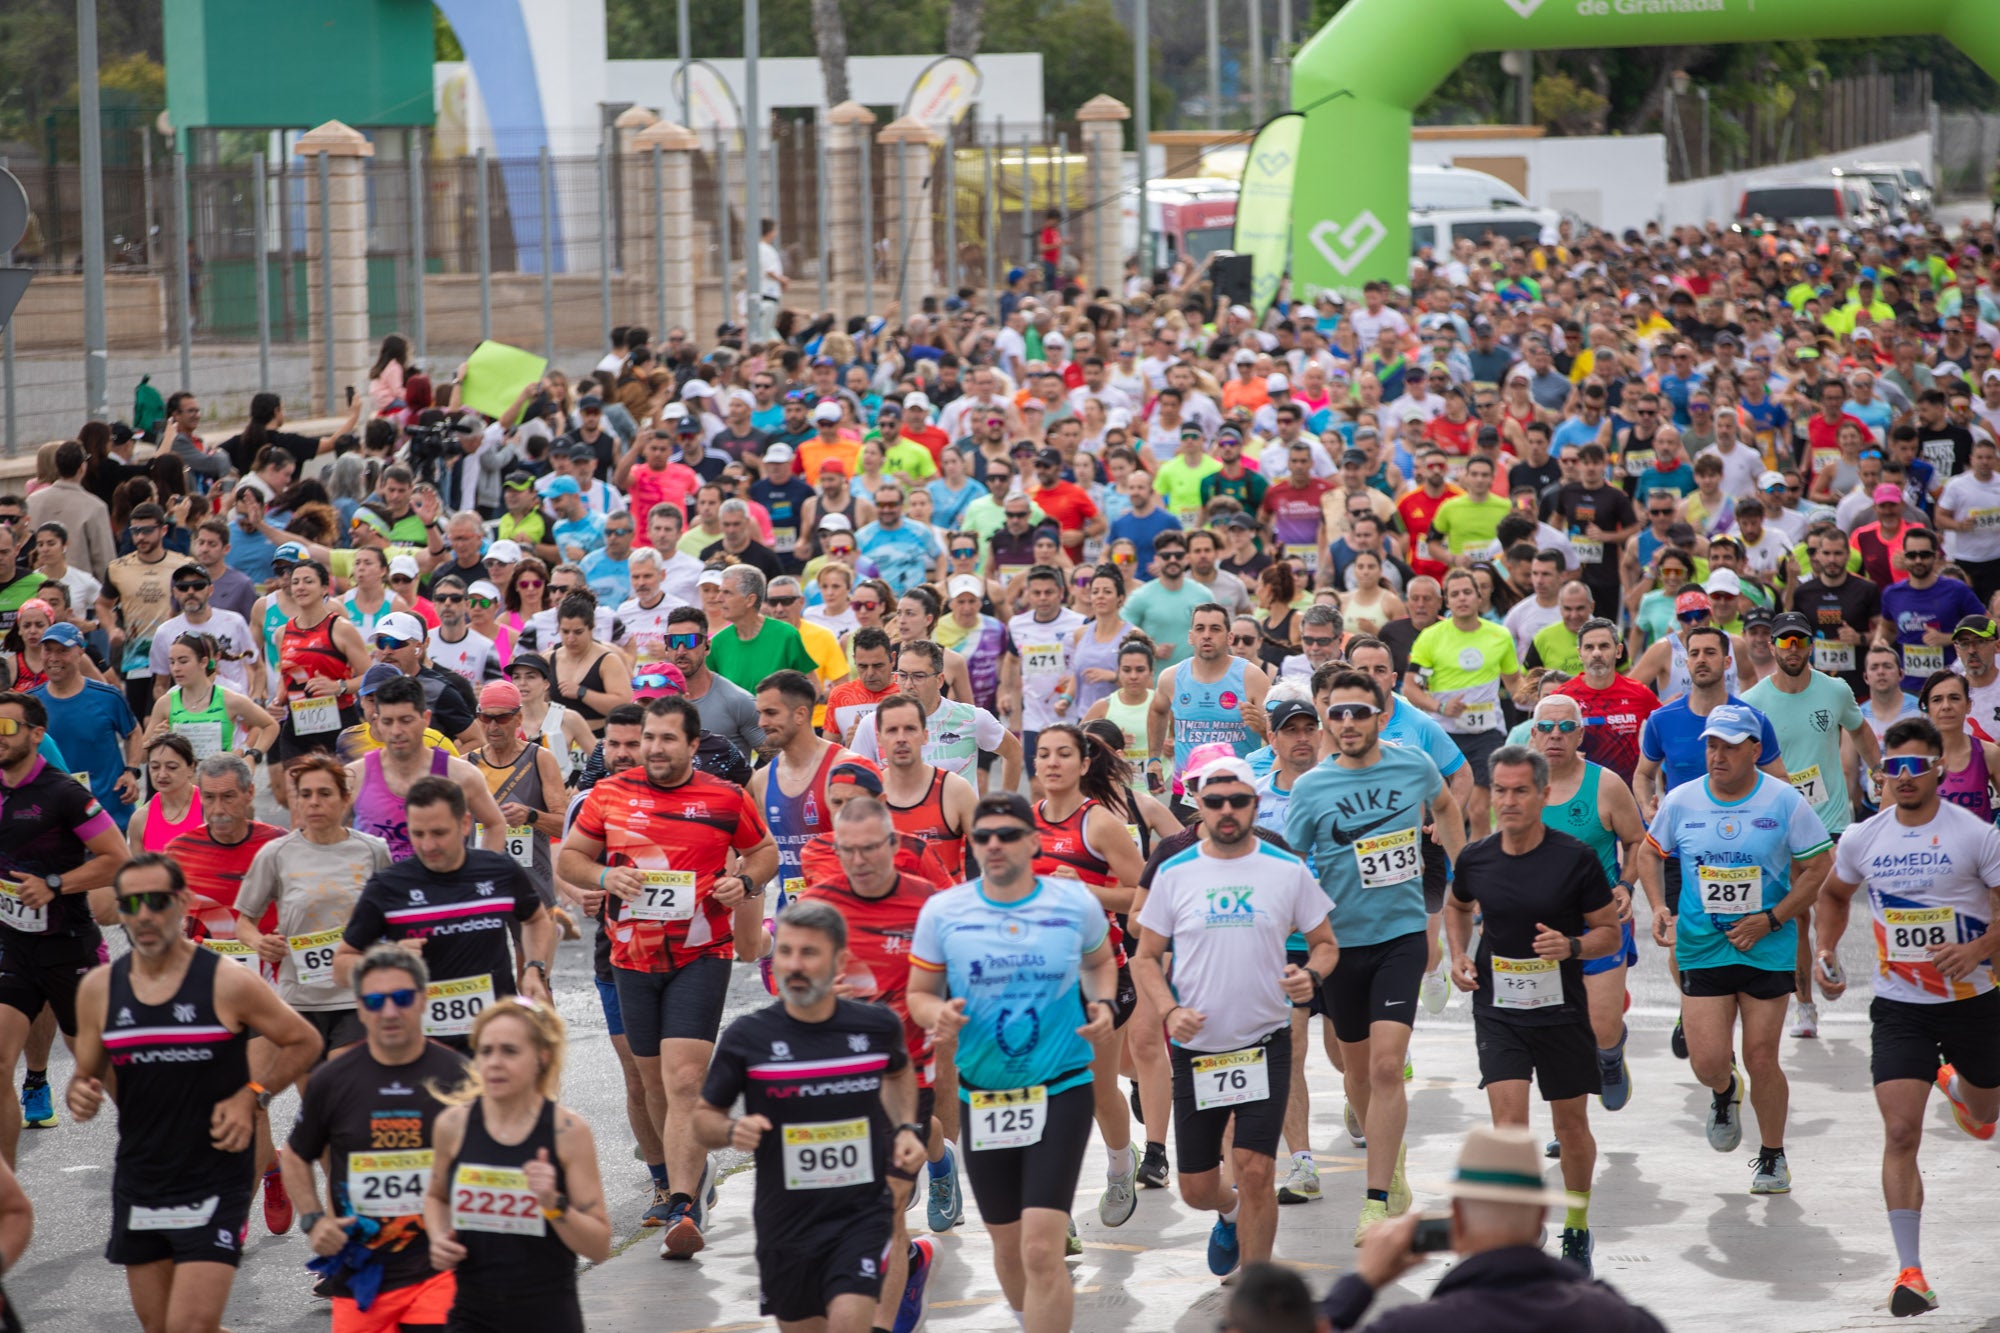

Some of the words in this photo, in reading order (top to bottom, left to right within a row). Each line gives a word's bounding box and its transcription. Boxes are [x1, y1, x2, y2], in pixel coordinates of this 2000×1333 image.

[1577, 0, 1609, 16] de
[1614, 0, 1724, 14] Granada
[1029, 654, 1057, 667] 471
[1907, 656, 1942, 669] 3046
[1467, 714, 1485, 726] 31
[1606, 713, 1637, 725] SEUR
[1187, 731, 1247, 743] ESTEPONA
[1335, 788, 1402, 819] NIKE
[1361, 846, 1417, 876] 3133
[1709, 851, 1753, 863] PINTURAS
[645, 888, 675, 907] 72
[1206, 891, 1253, 914] 10K
[1707, 883, 1752, 902] 287
[406, 917, 503, 938] runrundata
[1895, 927, 1946, 948] 808
[990, 954, 1046, 969] PINTURAS
[431, 997, 484, 1022] 880
[111, 1048, 213, 1067] unrundata
[766, 1076, 881, 1098] runrundata
[1214, 1069, 1247, 1093] 76
[984, 1108, 1034, 1134] 125
[371, 1131, 424, 1148] 2025
[799, 1144, 858, 1172] 960
[362, 1173, 424, 1200] 264
[456, 1189, 539, 1220] 2222
